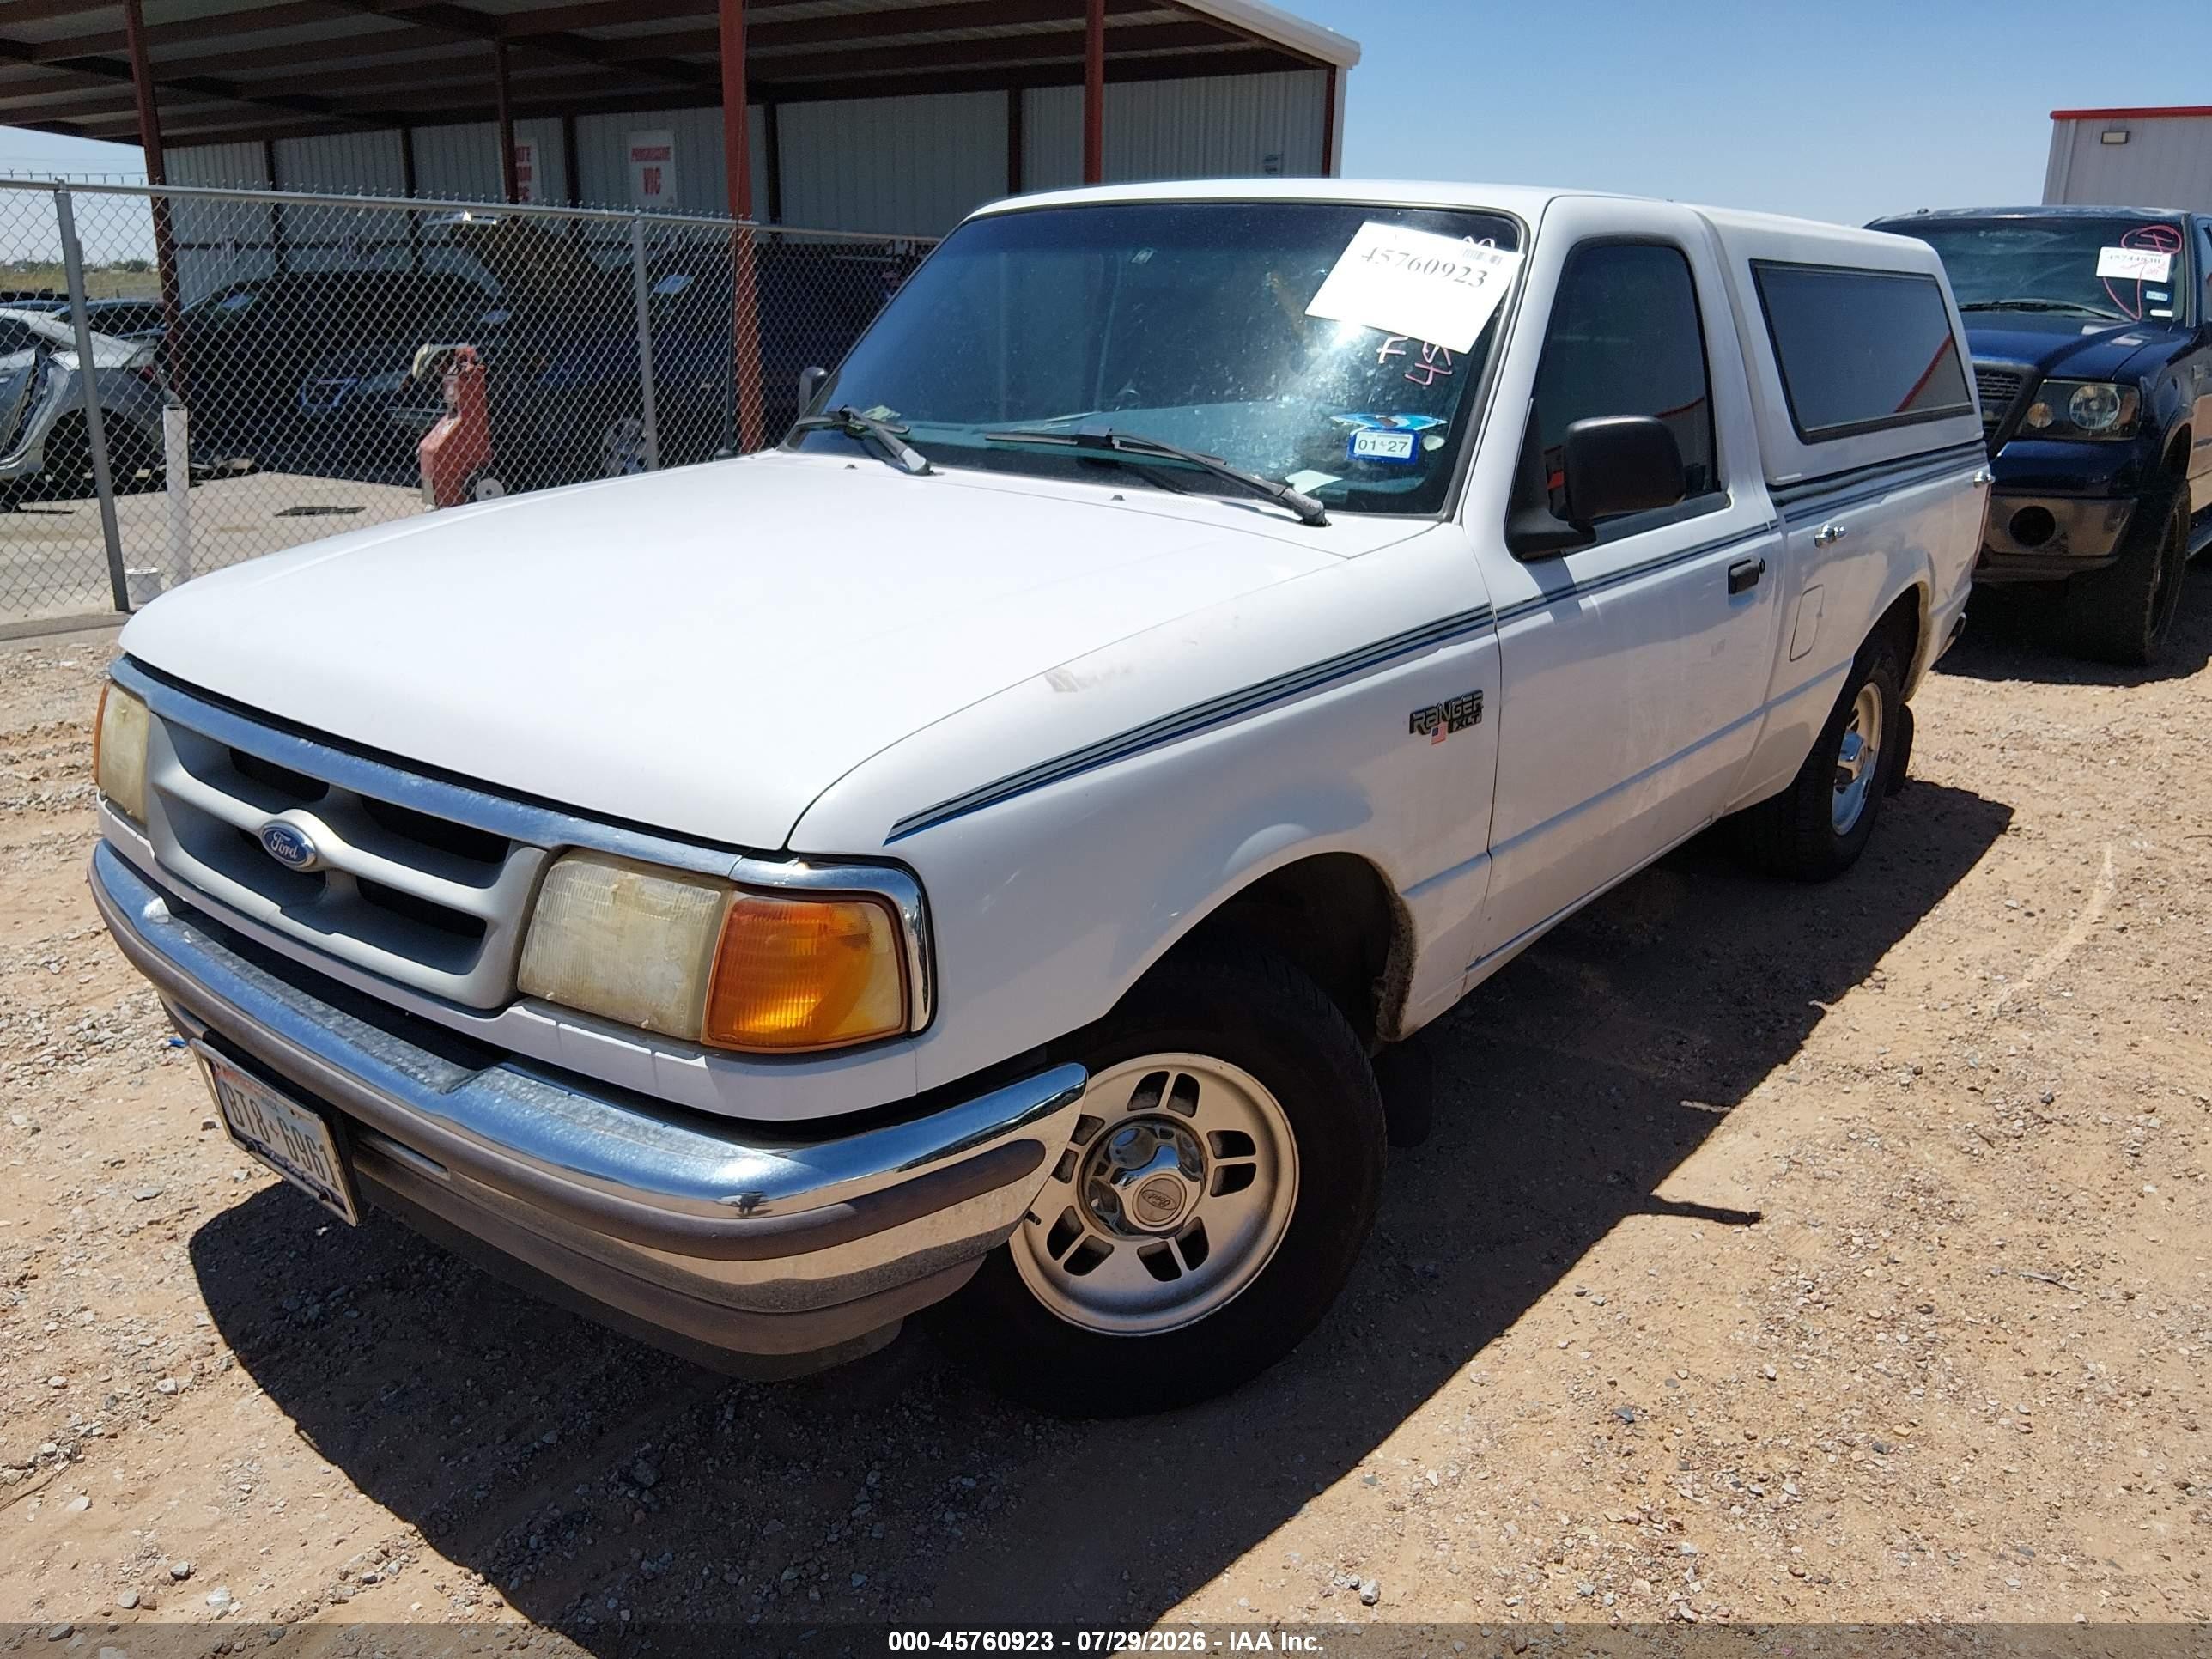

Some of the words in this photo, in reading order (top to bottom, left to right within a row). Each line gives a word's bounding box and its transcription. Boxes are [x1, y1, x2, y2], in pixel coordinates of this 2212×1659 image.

[1361, 246, 1488, 289] 45760923
[1409, 690, 1484, 735] RANGER
[1455, 713, 1482, 731] XLT
[271, 831, 298, 860] Ford
[1148, 1193, 1171, 1208] Ford
